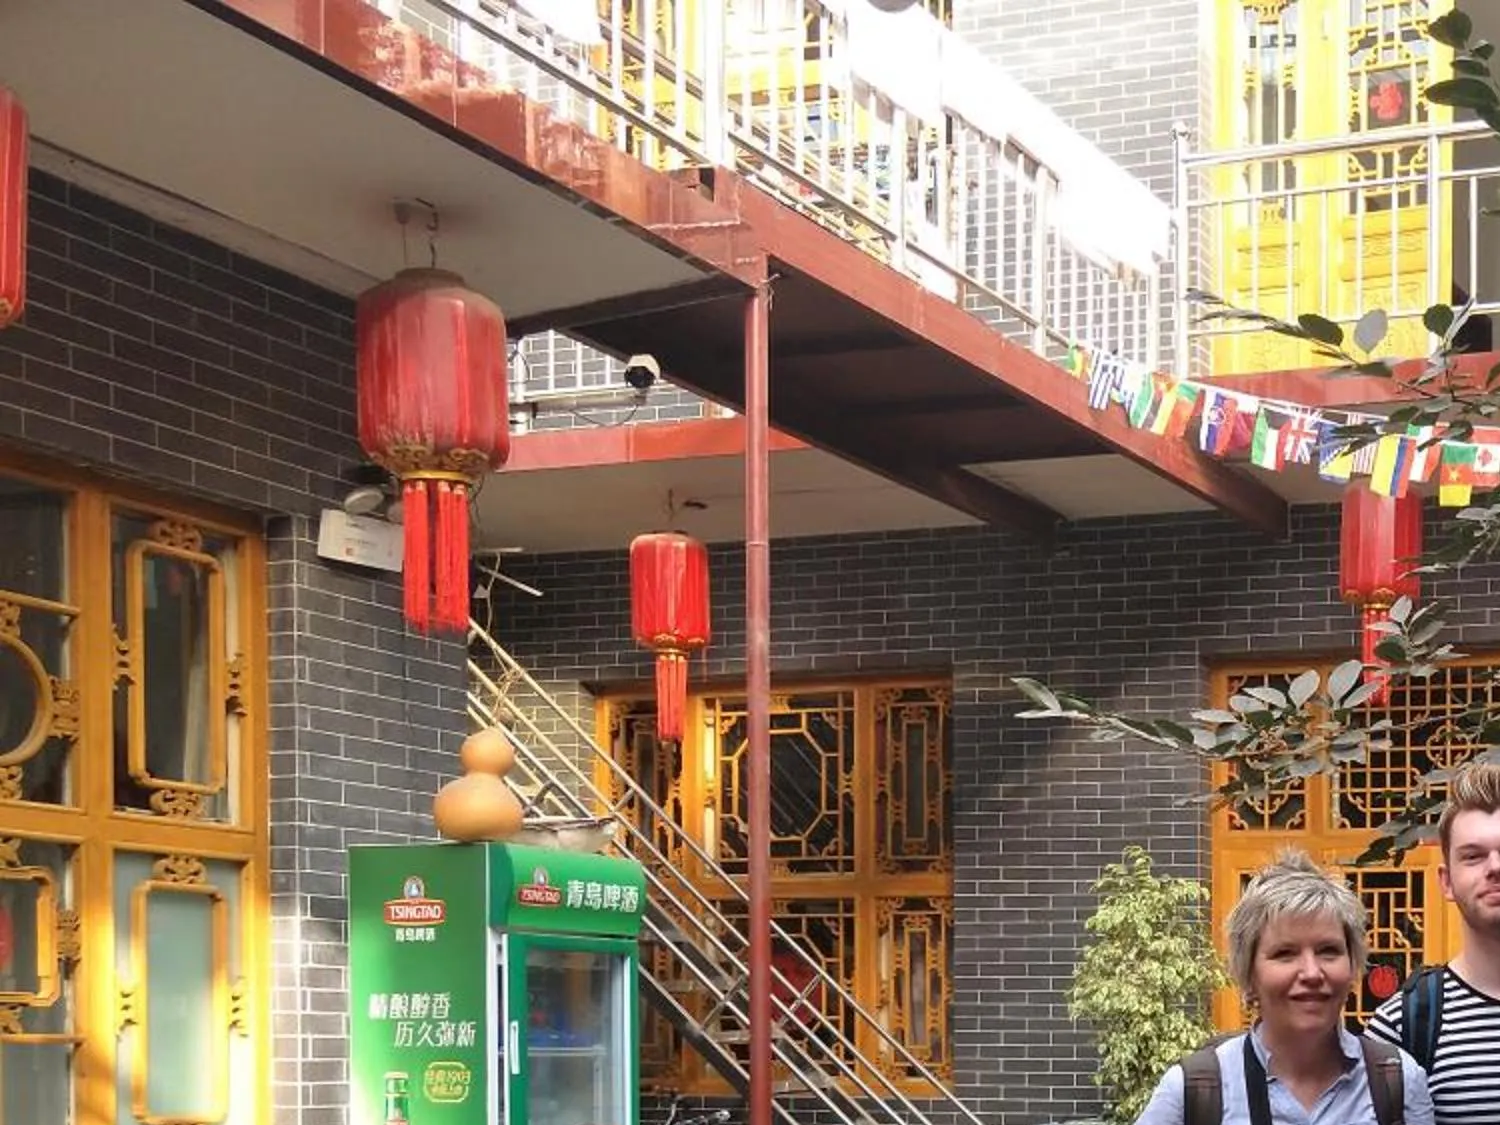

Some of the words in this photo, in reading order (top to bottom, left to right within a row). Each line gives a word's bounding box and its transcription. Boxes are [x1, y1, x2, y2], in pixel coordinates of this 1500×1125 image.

[566, 880, 639, 913] 青岛啤酒
[389, 905, 442, 920] TSINGTAO
